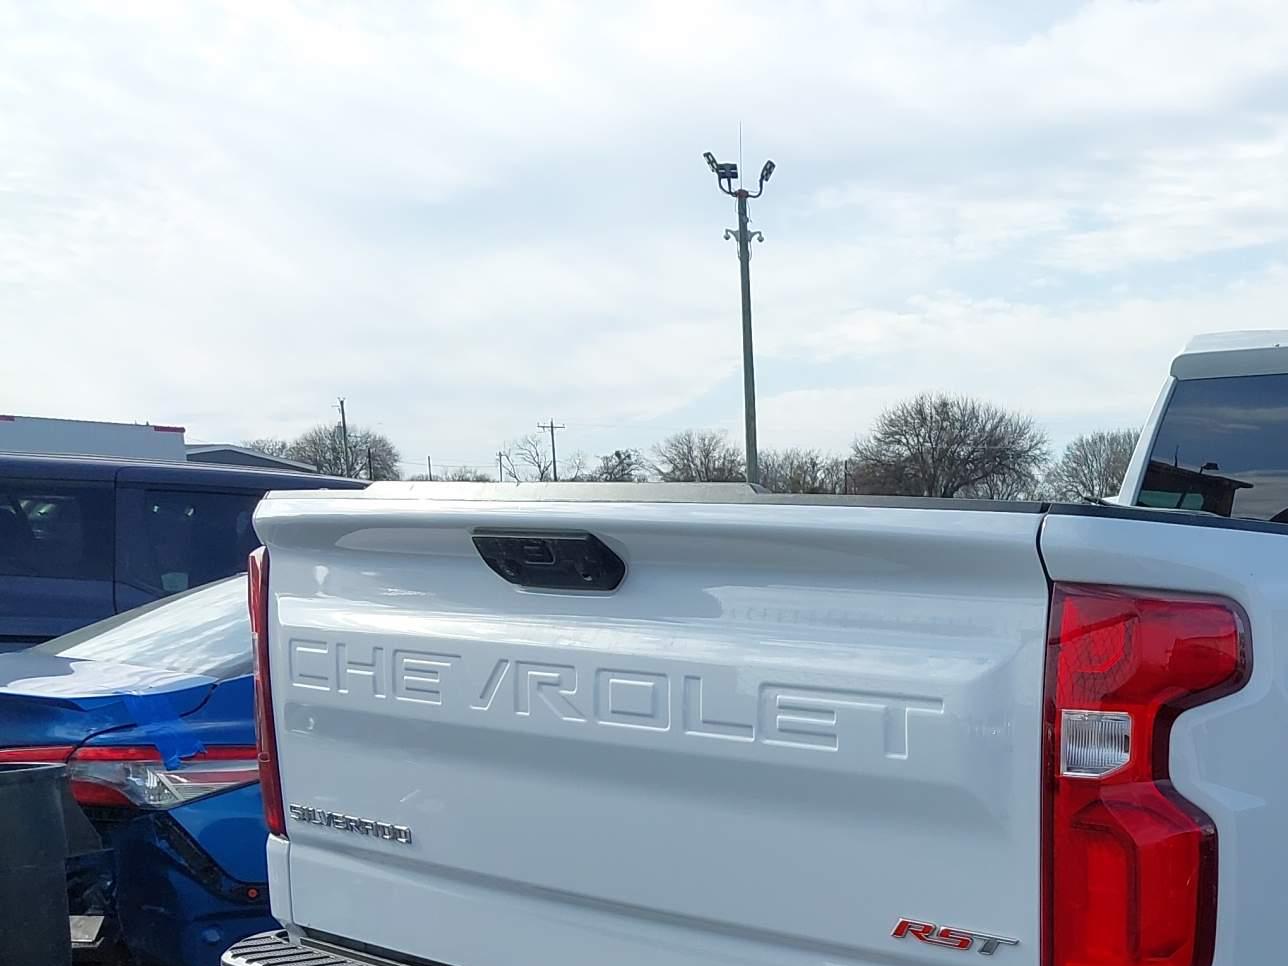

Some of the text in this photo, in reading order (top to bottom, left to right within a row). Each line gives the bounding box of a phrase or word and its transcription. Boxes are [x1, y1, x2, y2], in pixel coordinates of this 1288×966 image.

[288, 637, 944, 760] CHEVROLET
[289, 803, 412, 844] SILVERADO
[890, 917, 1020, 956] RST
